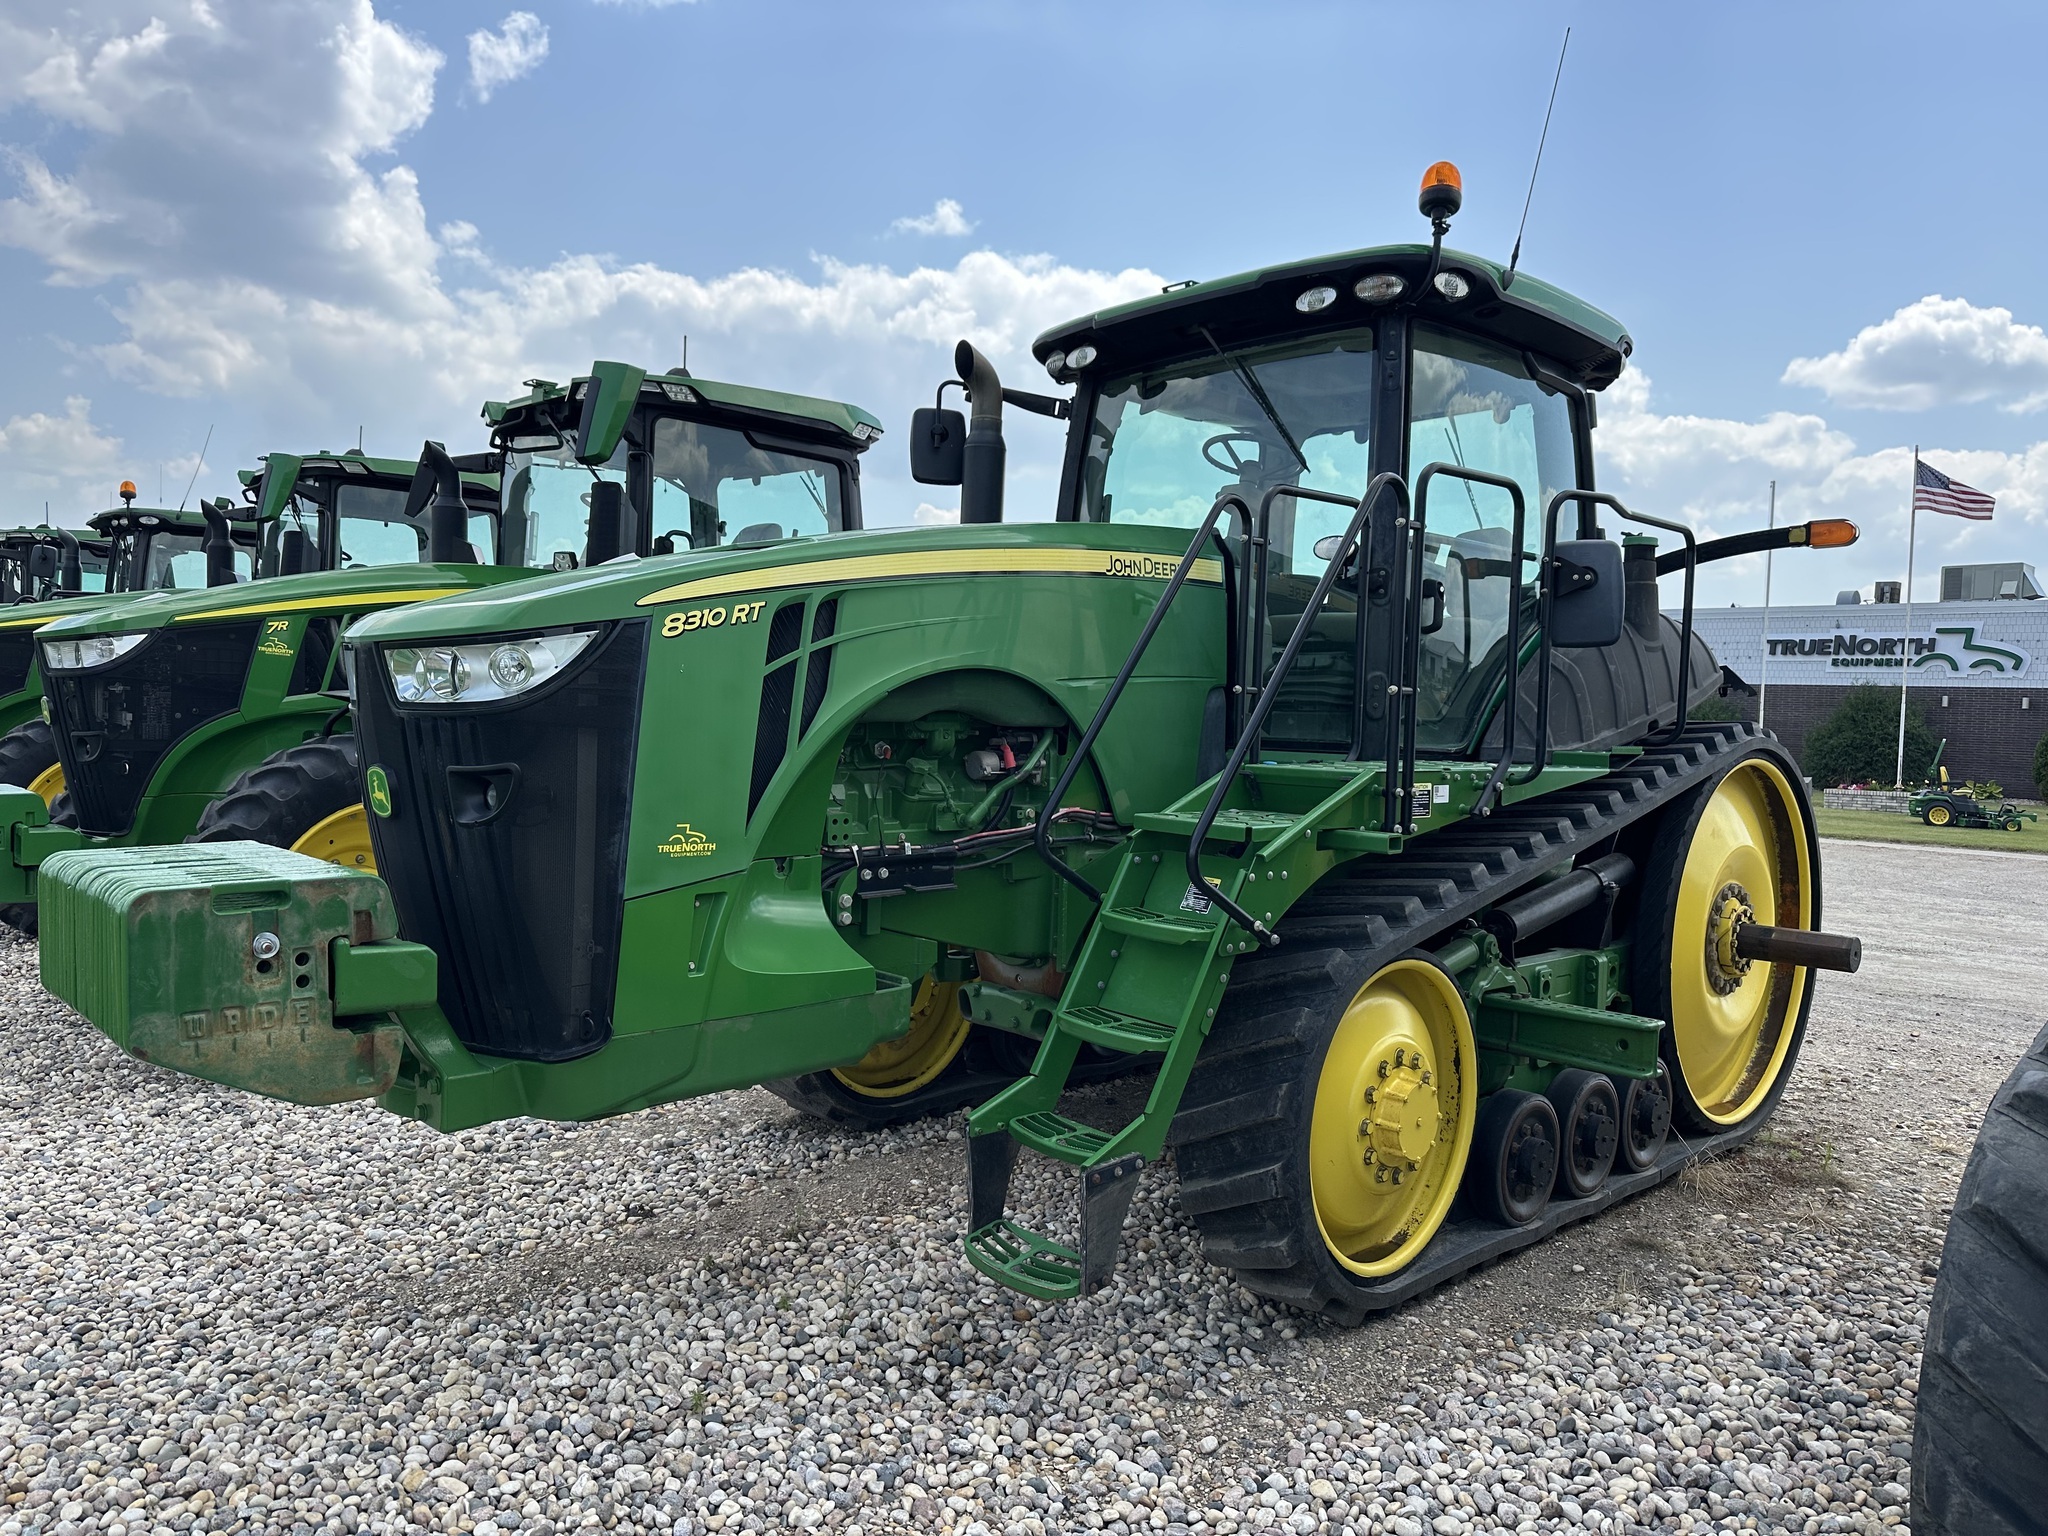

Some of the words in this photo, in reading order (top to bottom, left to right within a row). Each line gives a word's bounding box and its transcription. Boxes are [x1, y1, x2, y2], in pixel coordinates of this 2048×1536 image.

[1106, 555, 1141, 576] JOHN
[1143, 557, 1180, 577] DEER
[661, 607, 727, 638] 8310
[730, 601, 767, 626] RT
[266, 620, 289, 634] 7R
[1766, 634, 1936, 656] TRUENORTH
[1831, 657, 1913, 667] EQUIPMENT
[657, 842, 716, 853] TRUENORTH
[670, 850, 712, 858] EQUIPMENT.COM
